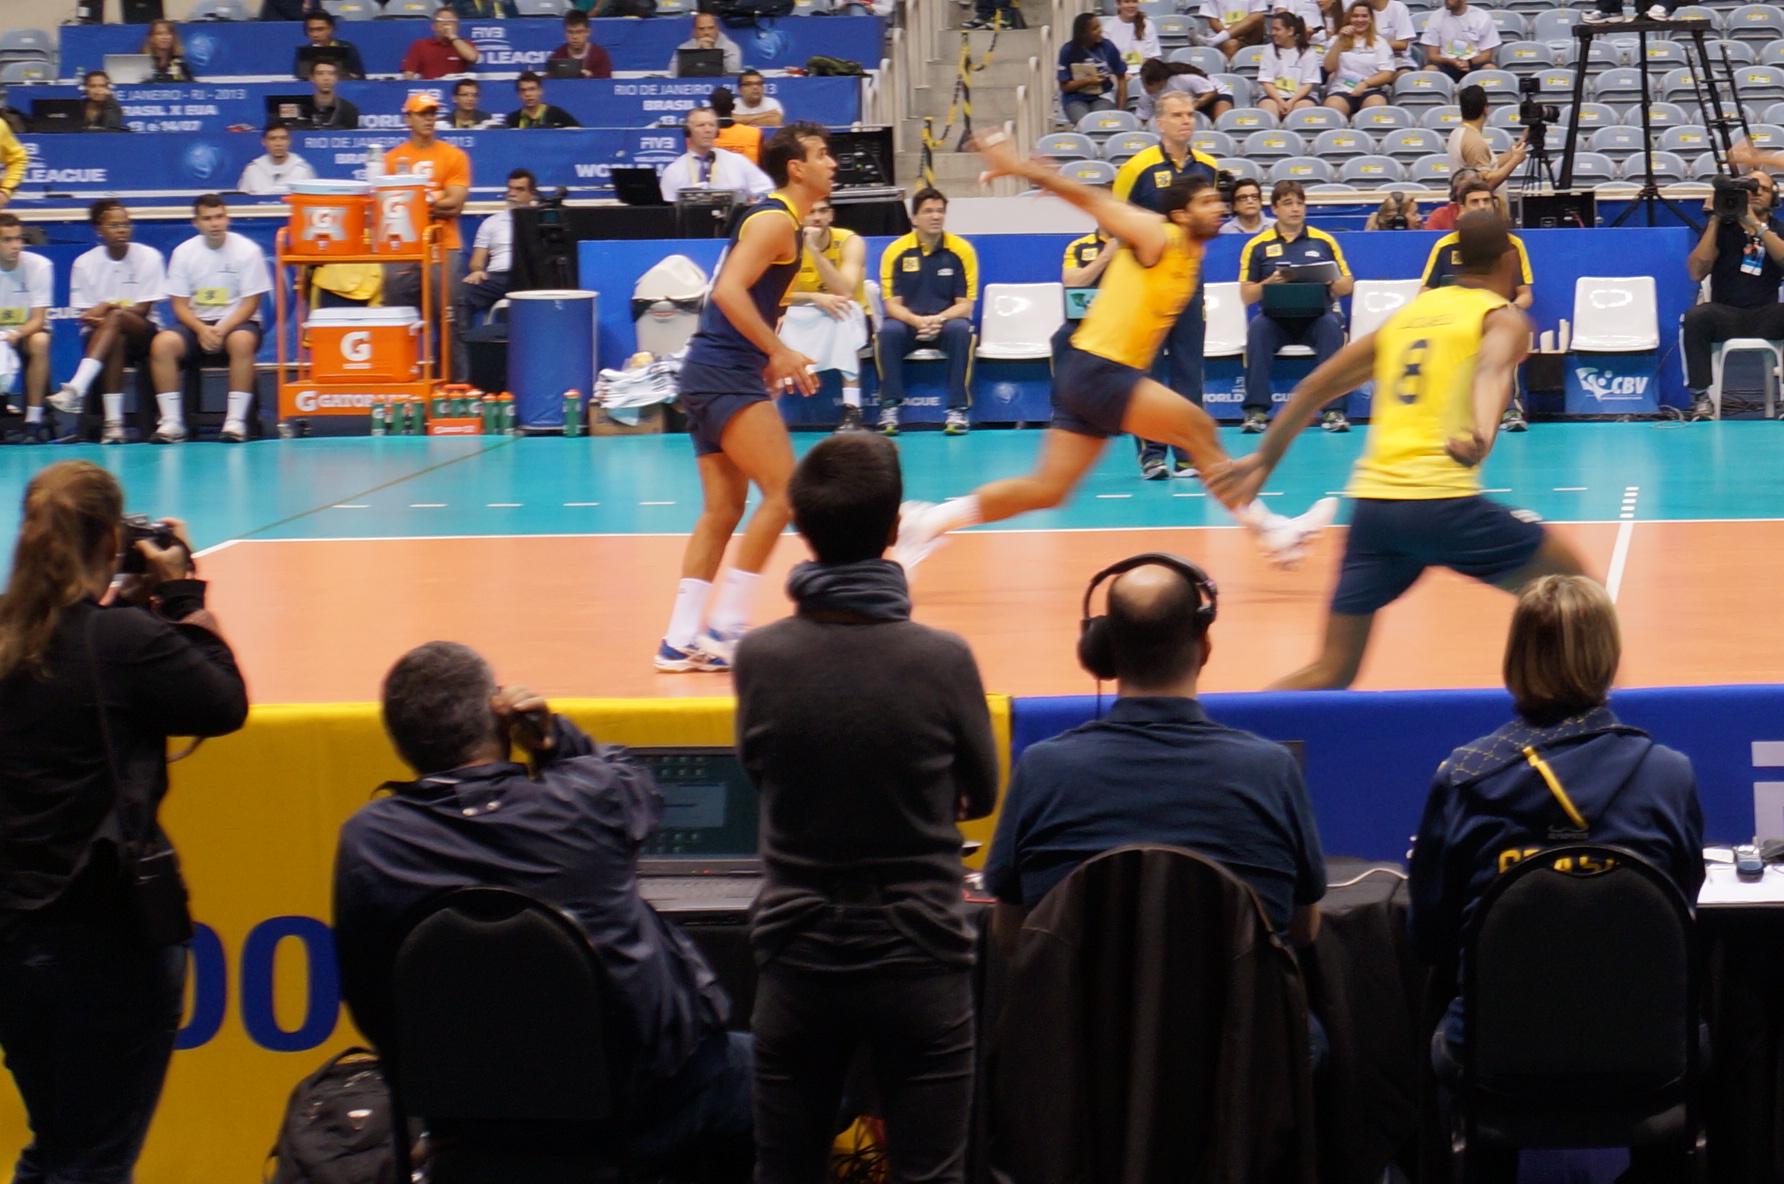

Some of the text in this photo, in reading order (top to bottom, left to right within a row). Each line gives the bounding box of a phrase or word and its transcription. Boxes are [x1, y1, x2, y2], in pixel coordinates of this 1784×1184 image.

[614, 85, 636, 96] RIO
[639, 84, 657, 96] DE
[660, 84, 713, 96] JANEIRO
[183, 105, 219, 116] EUA
[642, 100, 695, 112] BRASIL
[304, 137, 329, 149] RIO
[640, 137, 677, 149] FIVB
[340, 331, 373, 362] G
[1392, 338, 1430, 406] 8
[1611, 376, 1649, 395] CBV
[295, 390, 319, 412] G
[901, 396, 941, 407] AGUE
